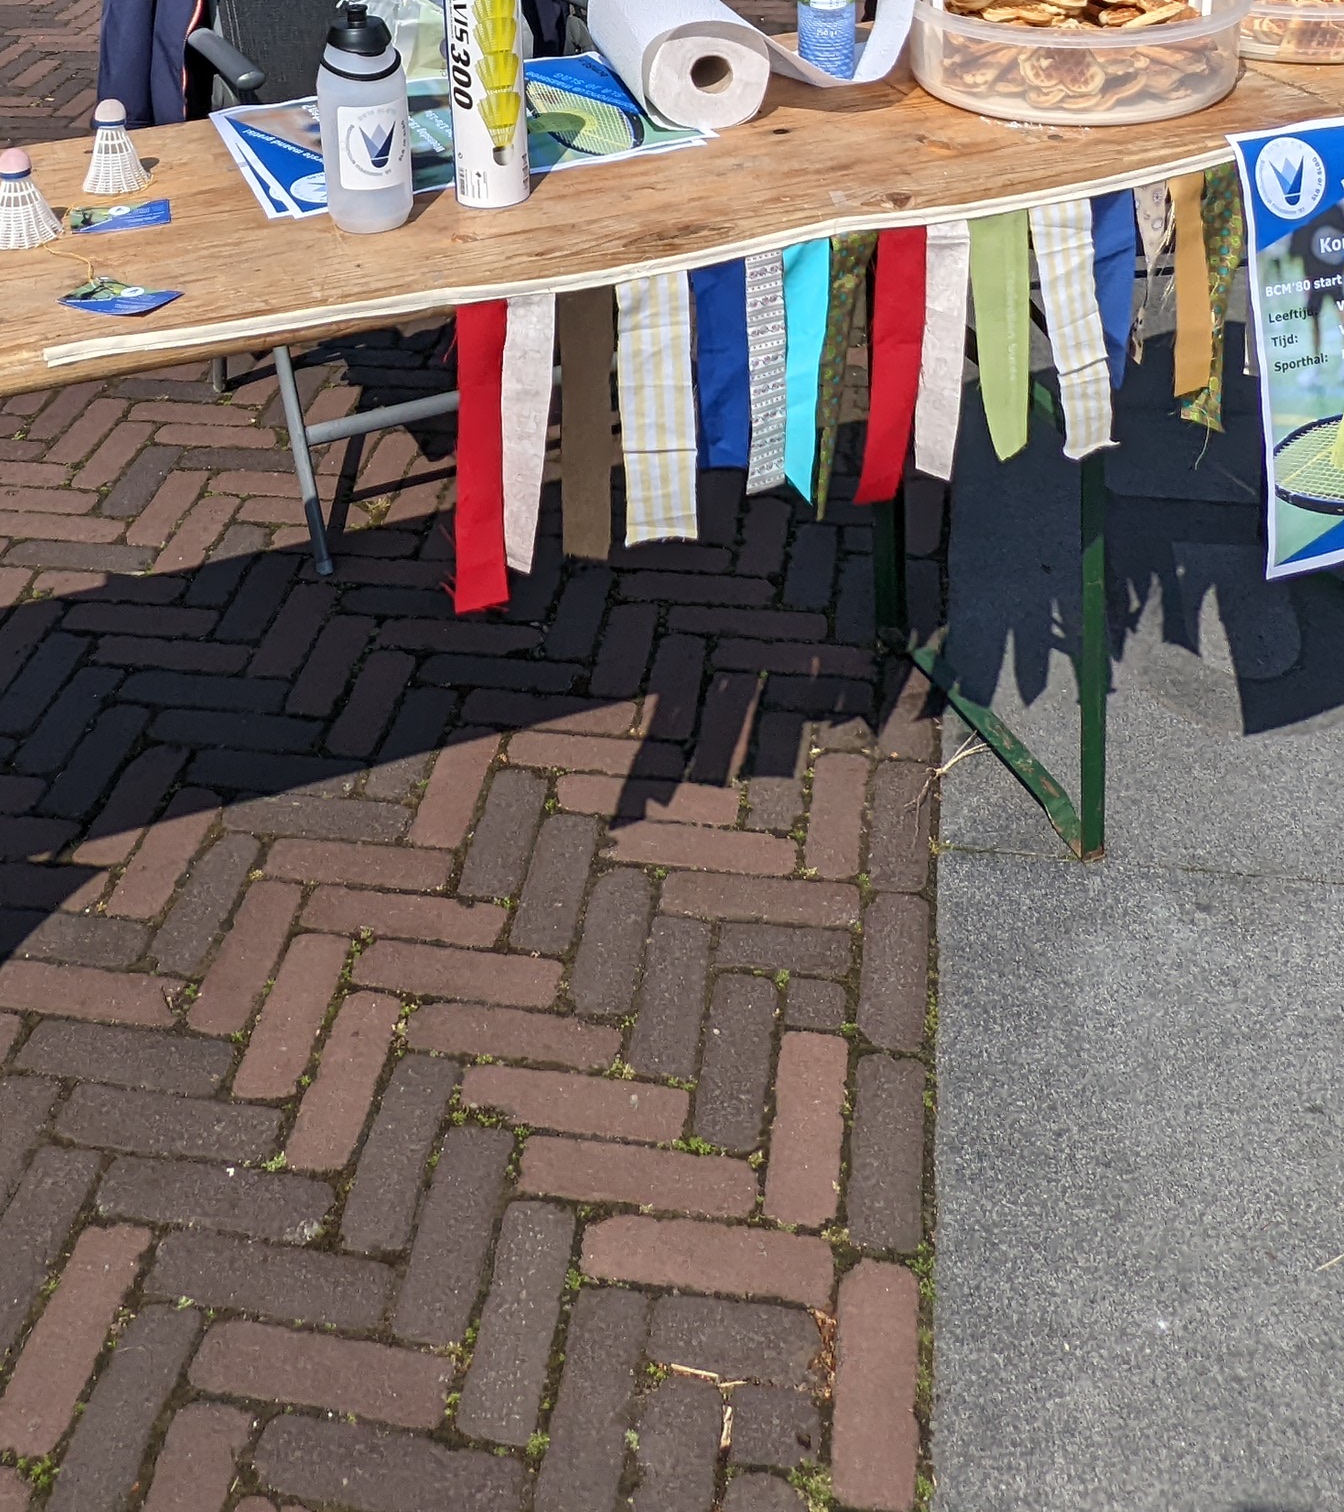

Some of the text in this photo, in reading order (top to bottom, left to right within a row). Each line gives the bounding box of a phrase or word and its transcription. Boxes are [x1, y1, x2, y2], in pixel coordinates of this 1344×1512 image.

[451, 43, 474, 112] 300
[1314, 275, 1343, 289] start
[1271, 334, 1298, 348] Tijd:
[1274, 353, 1328, 373] Sporthal:
